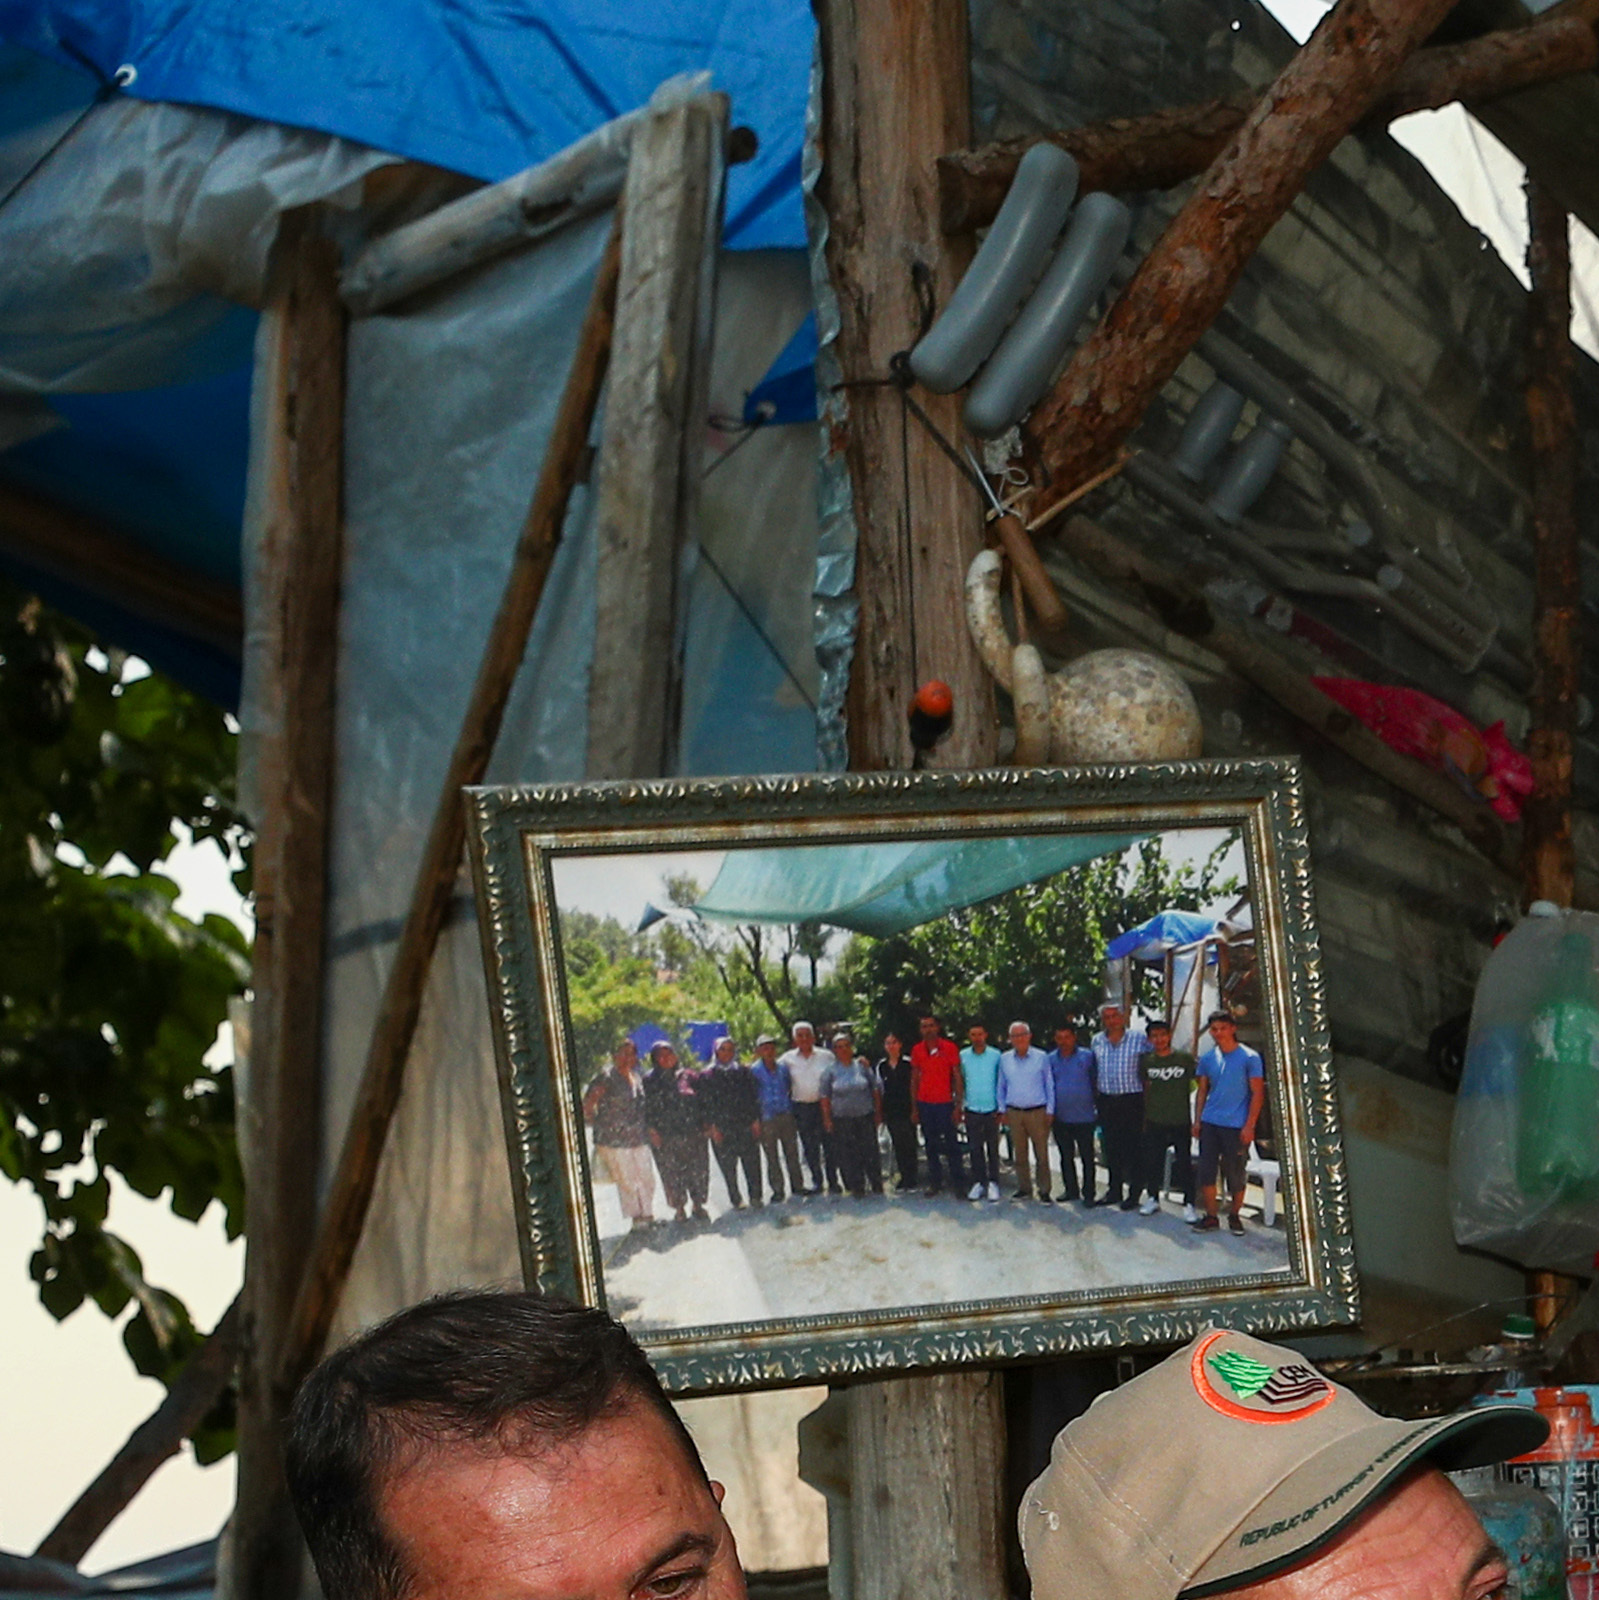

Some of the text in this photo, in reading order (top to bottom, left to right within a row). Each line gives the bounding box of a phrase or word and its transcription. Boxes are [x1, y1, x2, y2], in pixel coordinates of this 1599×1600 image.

[1239, 1464, 1375, 1548] REPUBLIC OF TURKEY
